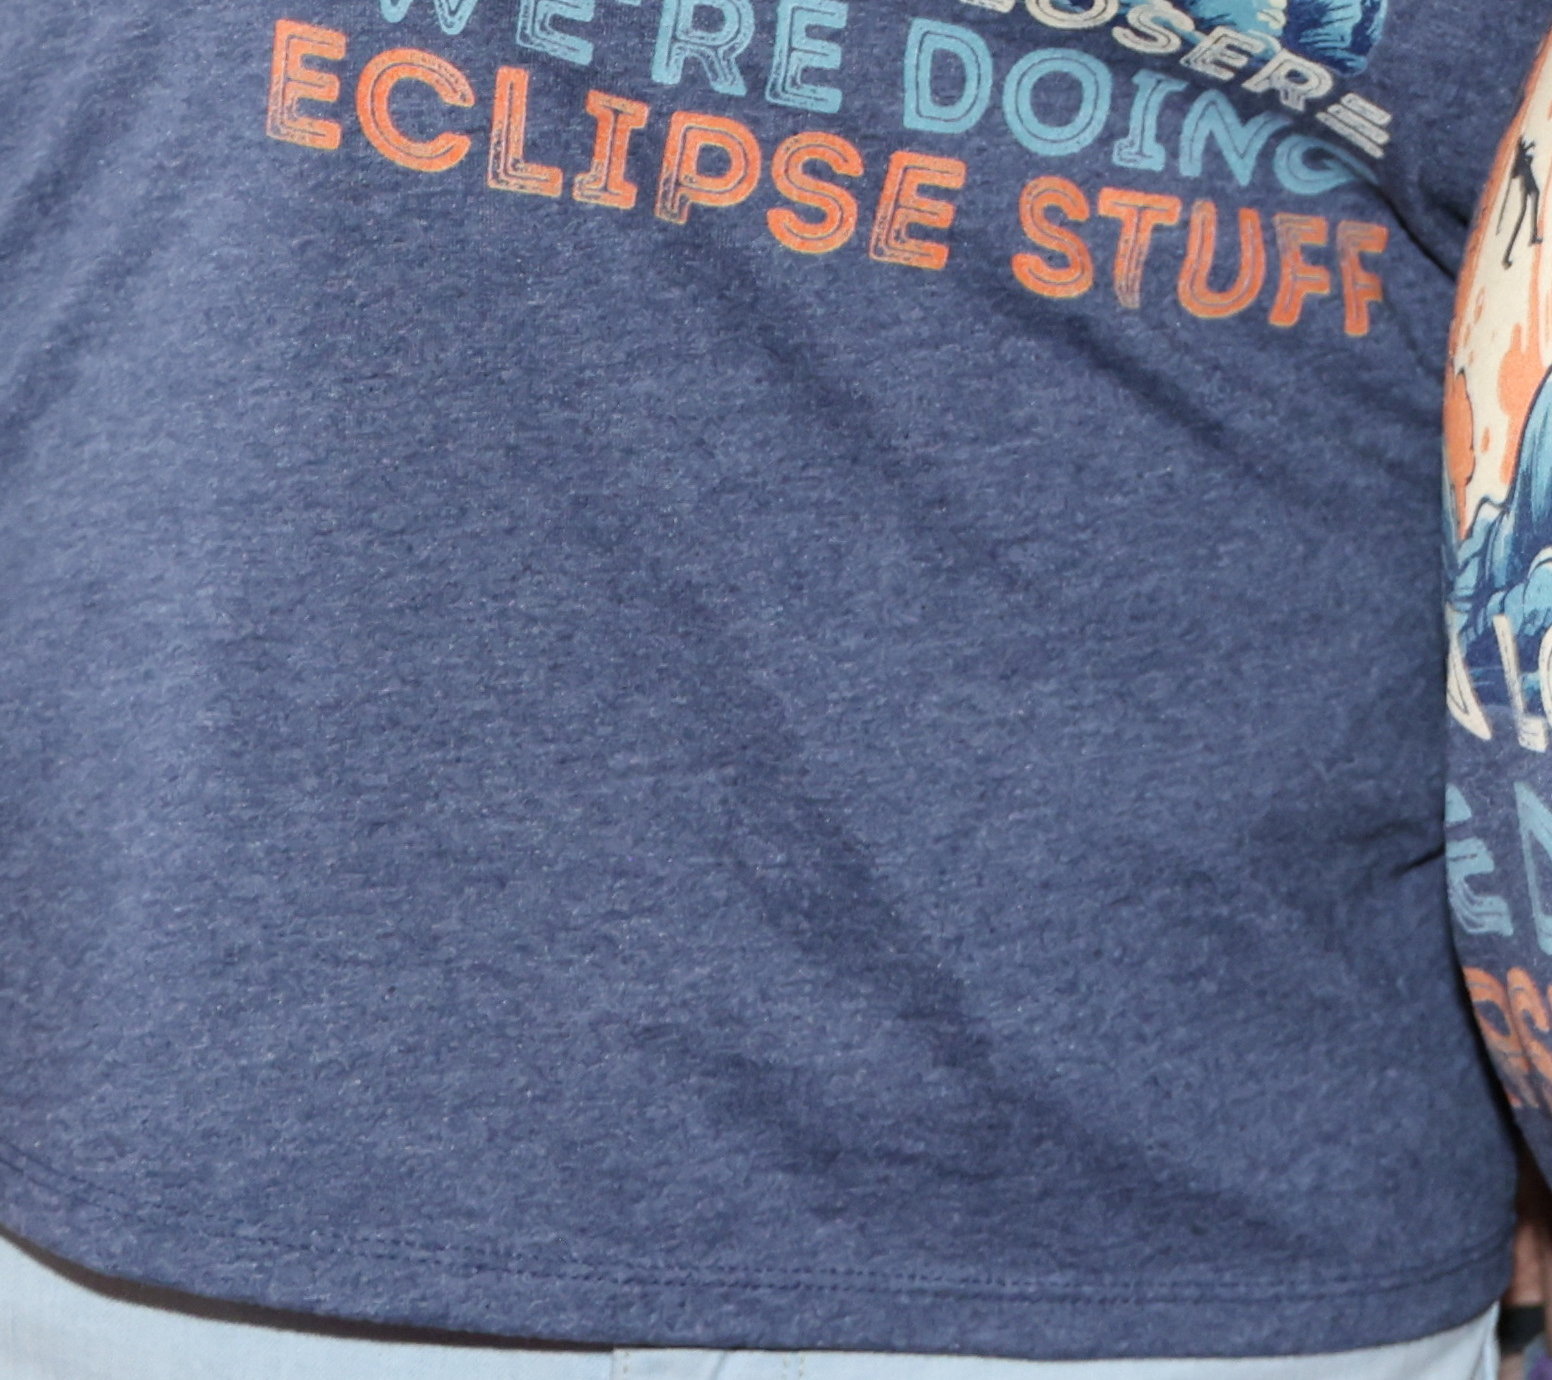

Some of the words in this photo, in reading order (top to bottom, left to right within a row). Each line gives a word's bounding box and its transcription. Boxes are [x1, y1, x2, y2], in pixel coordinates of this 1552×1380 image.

[263, 17, 968, 273] ECLIPSE
[1009, 176, 1391, 338] STUFF
[901, 17, 1378, 197] DOING
